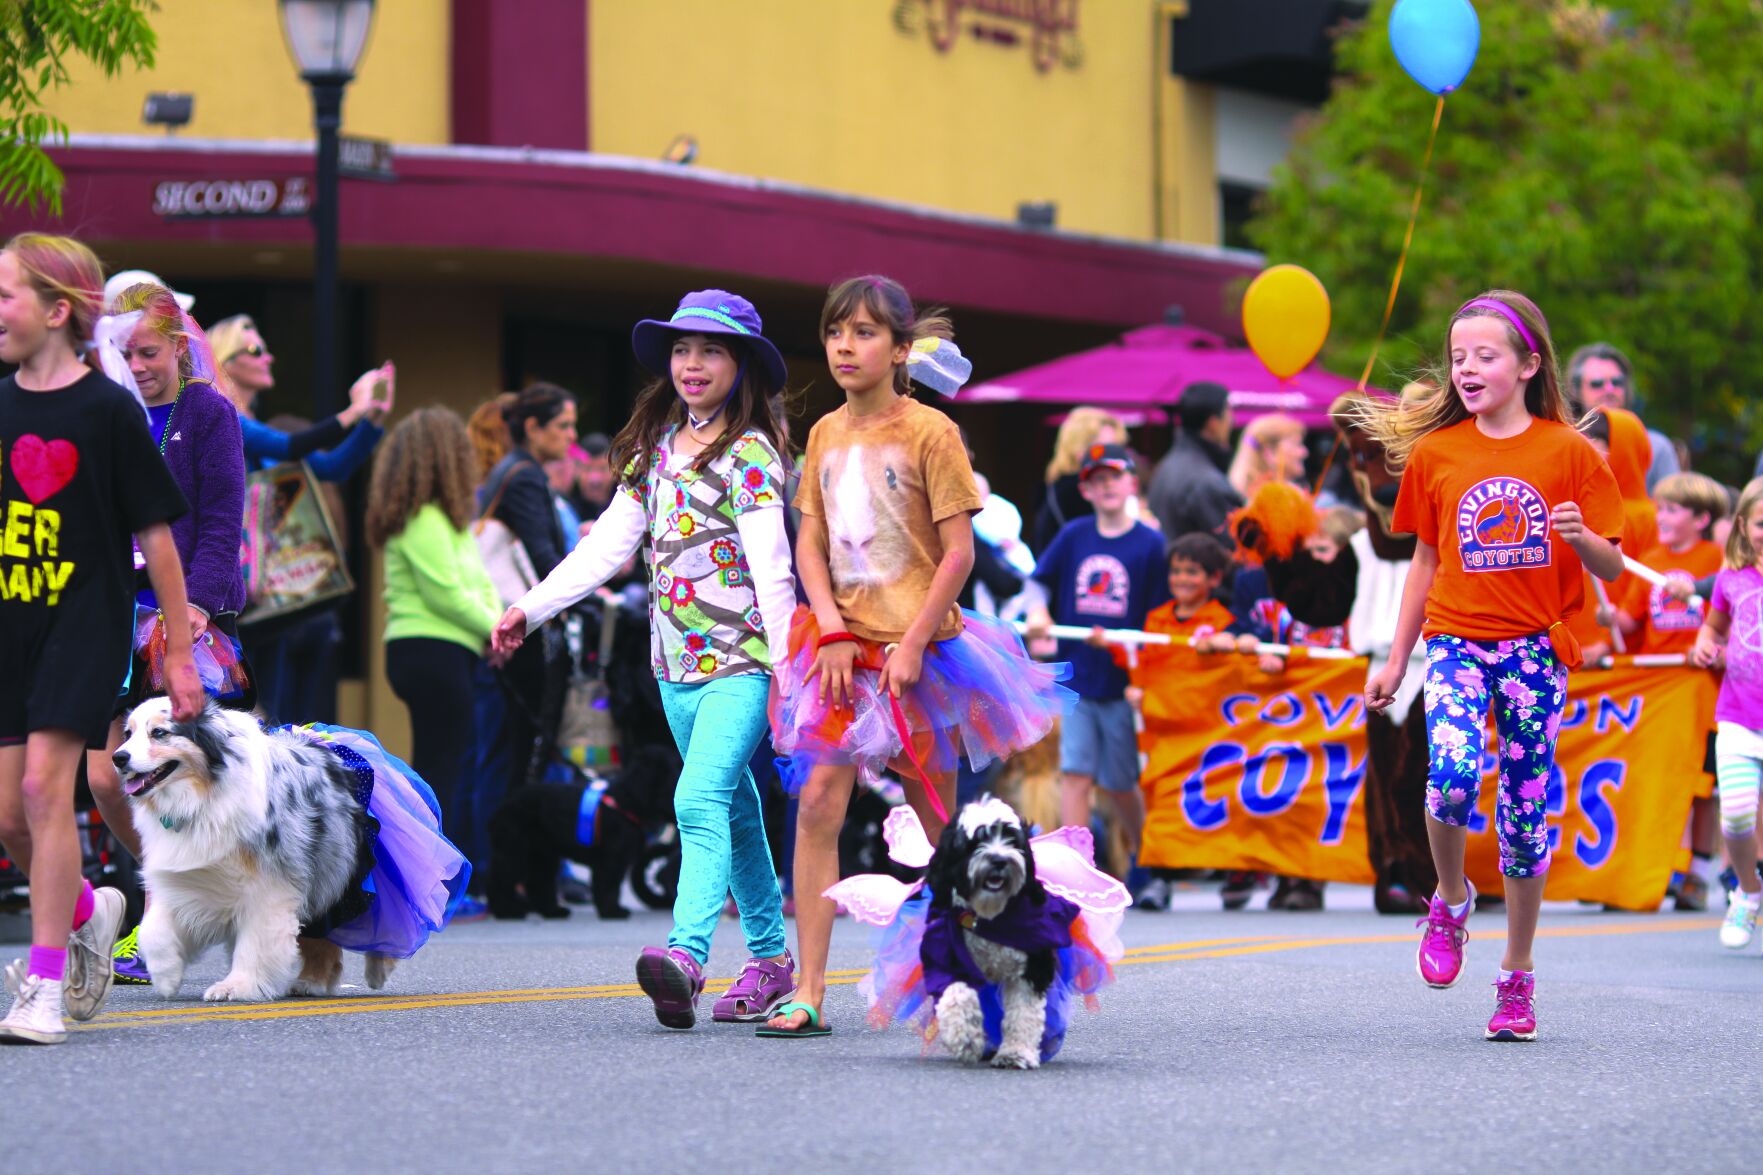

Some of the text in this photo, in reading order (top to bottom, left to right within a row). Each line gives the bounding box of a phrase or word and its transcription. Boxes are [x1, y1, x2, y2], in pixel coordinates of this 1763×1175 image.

[154, 180, 278, 215] SECOND
[0, 499, 61, 559] ER
[1459, 481, 1545, 544] COVINGTON
[1464, 546, 1545, 567] COYOTES
